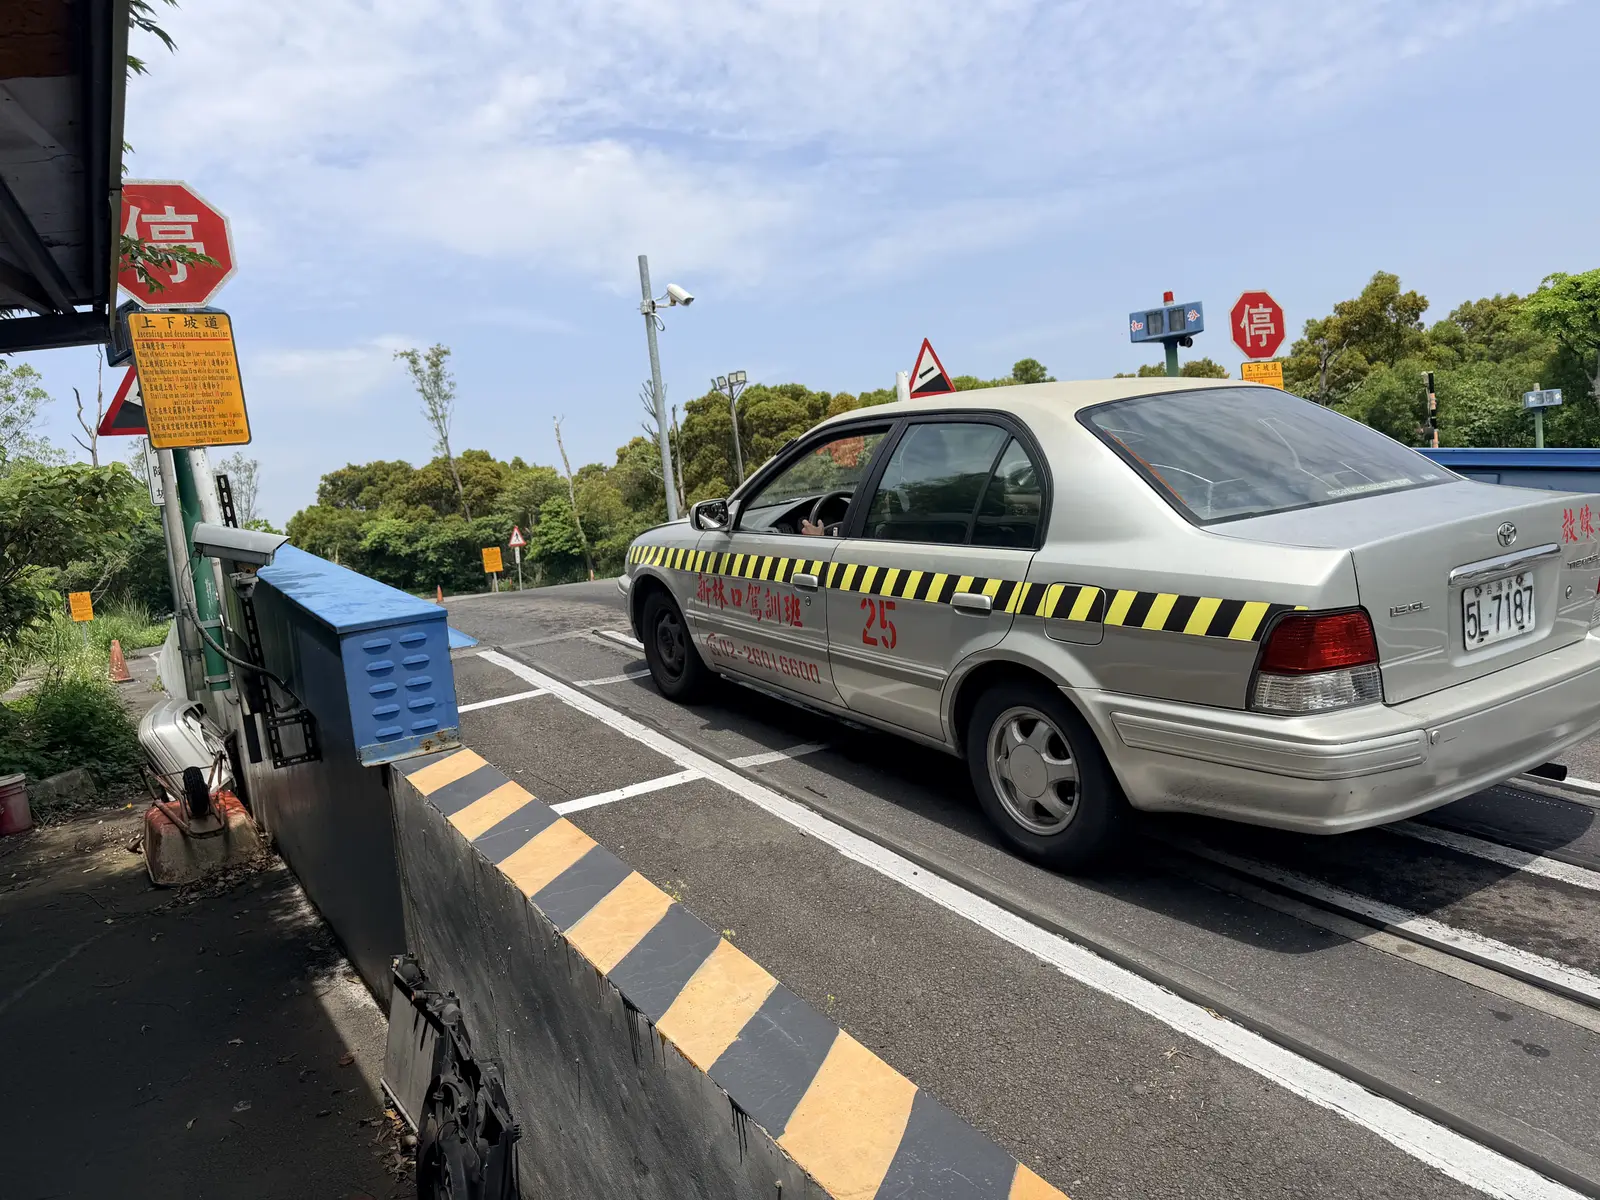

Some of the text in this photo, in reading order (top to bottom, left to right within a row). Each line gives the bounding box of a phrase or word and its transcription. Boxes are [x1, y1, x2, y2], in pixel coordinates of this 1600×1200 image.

[122, 205, 206, 284] 停
[141, 316, 220, 329] 上下坡道
[164, 330, 173, 338] and
[174, 329, 202, 338] descending
[1239, 303, 1276, 348] 停
[1562, 504, 1600, 544] 教練
[697, 572, 803, 628] 新林口駕訓班
[860, 597, 897, 650] 25
